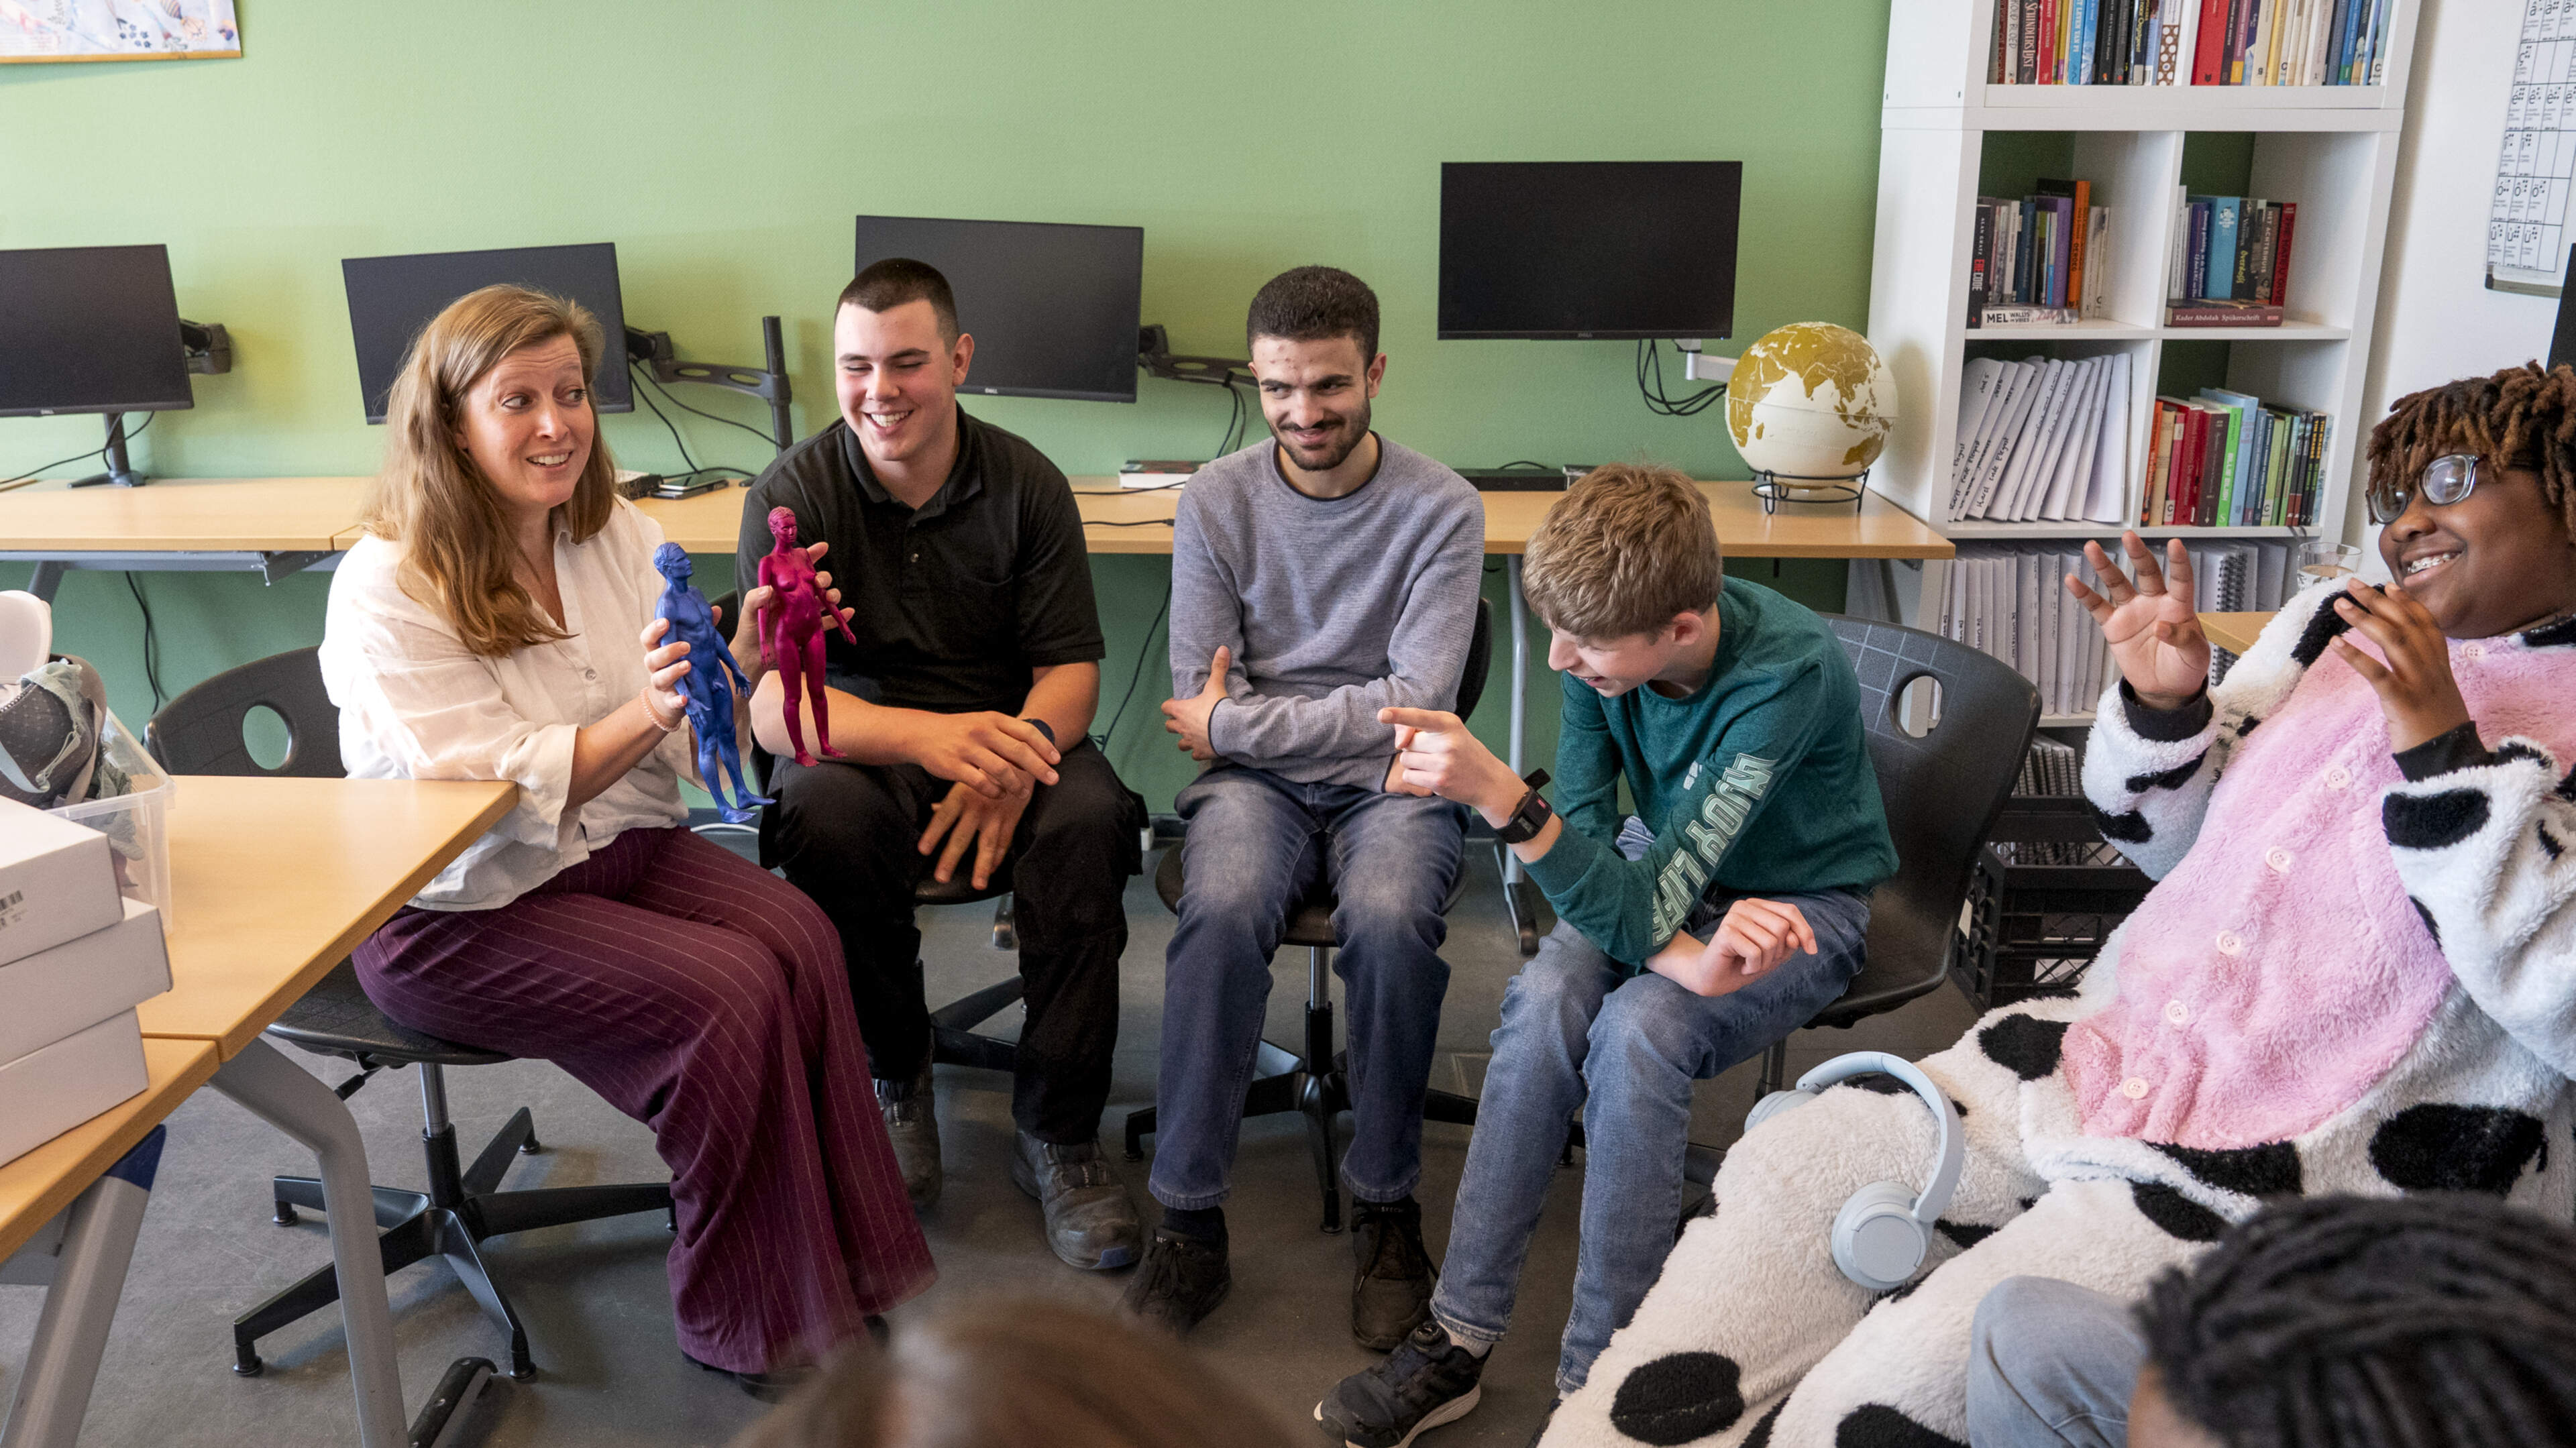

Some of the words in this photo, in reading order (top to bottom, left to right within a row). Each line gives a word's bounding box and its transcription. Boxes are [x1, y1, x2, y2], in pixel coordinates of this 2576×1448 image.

[1986, 313, 2008, 323] MEL
[1995, 437, 2009, 461] Elegast
[2224, 452, 2234, 476] BILLIE
[2222, 478, 2231, 501] EILISH
[1652, 847, 1709, 947] LIFE
